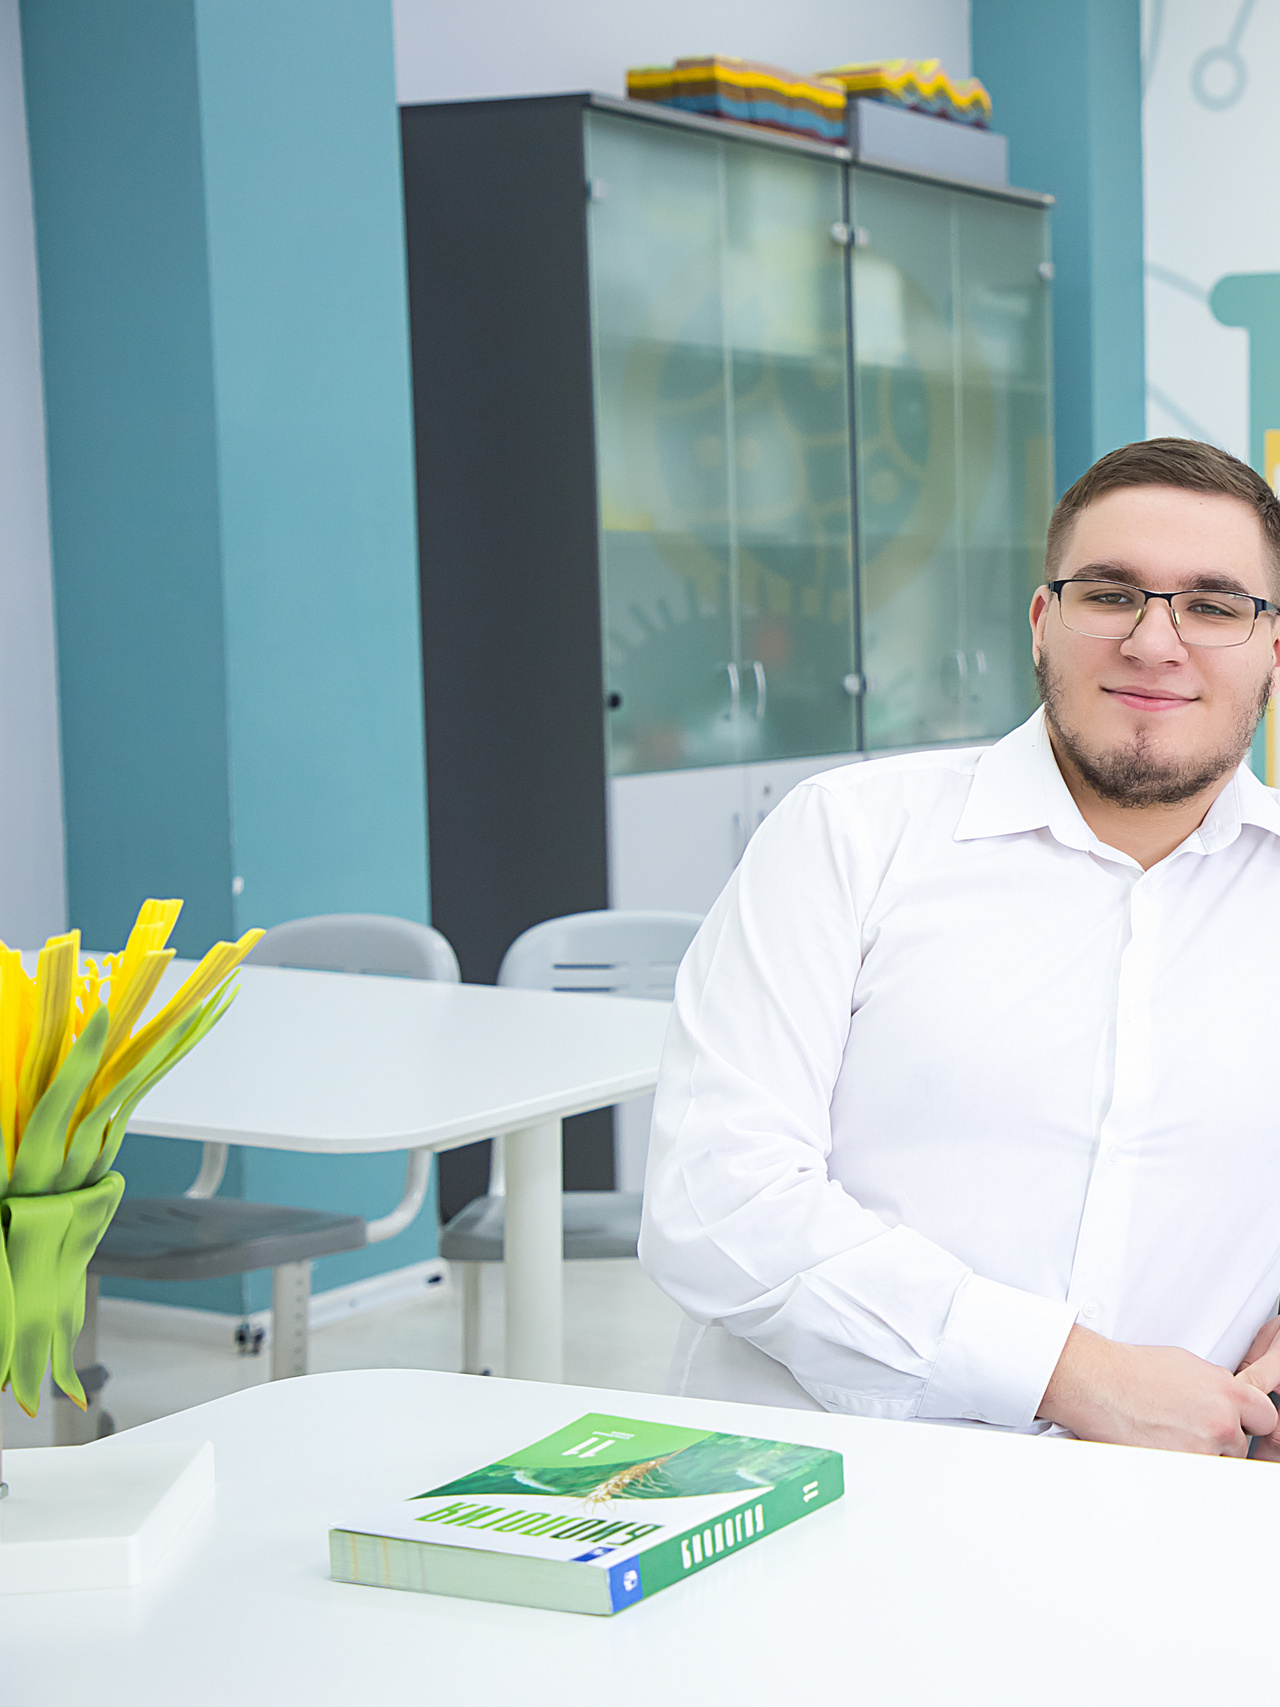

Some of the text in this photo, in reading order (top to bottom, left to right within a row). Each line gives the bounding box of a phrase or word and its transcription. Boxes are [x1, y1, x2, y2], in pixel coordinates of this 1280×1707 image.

[561, 1436, 616, 1459] 11
[802, 1480, 820, 1503] 11
[413, 1501, 667, 1546] БИОЛОГИЯ
[680, 1503, 765, 1570] БИОЛОГИЯ
